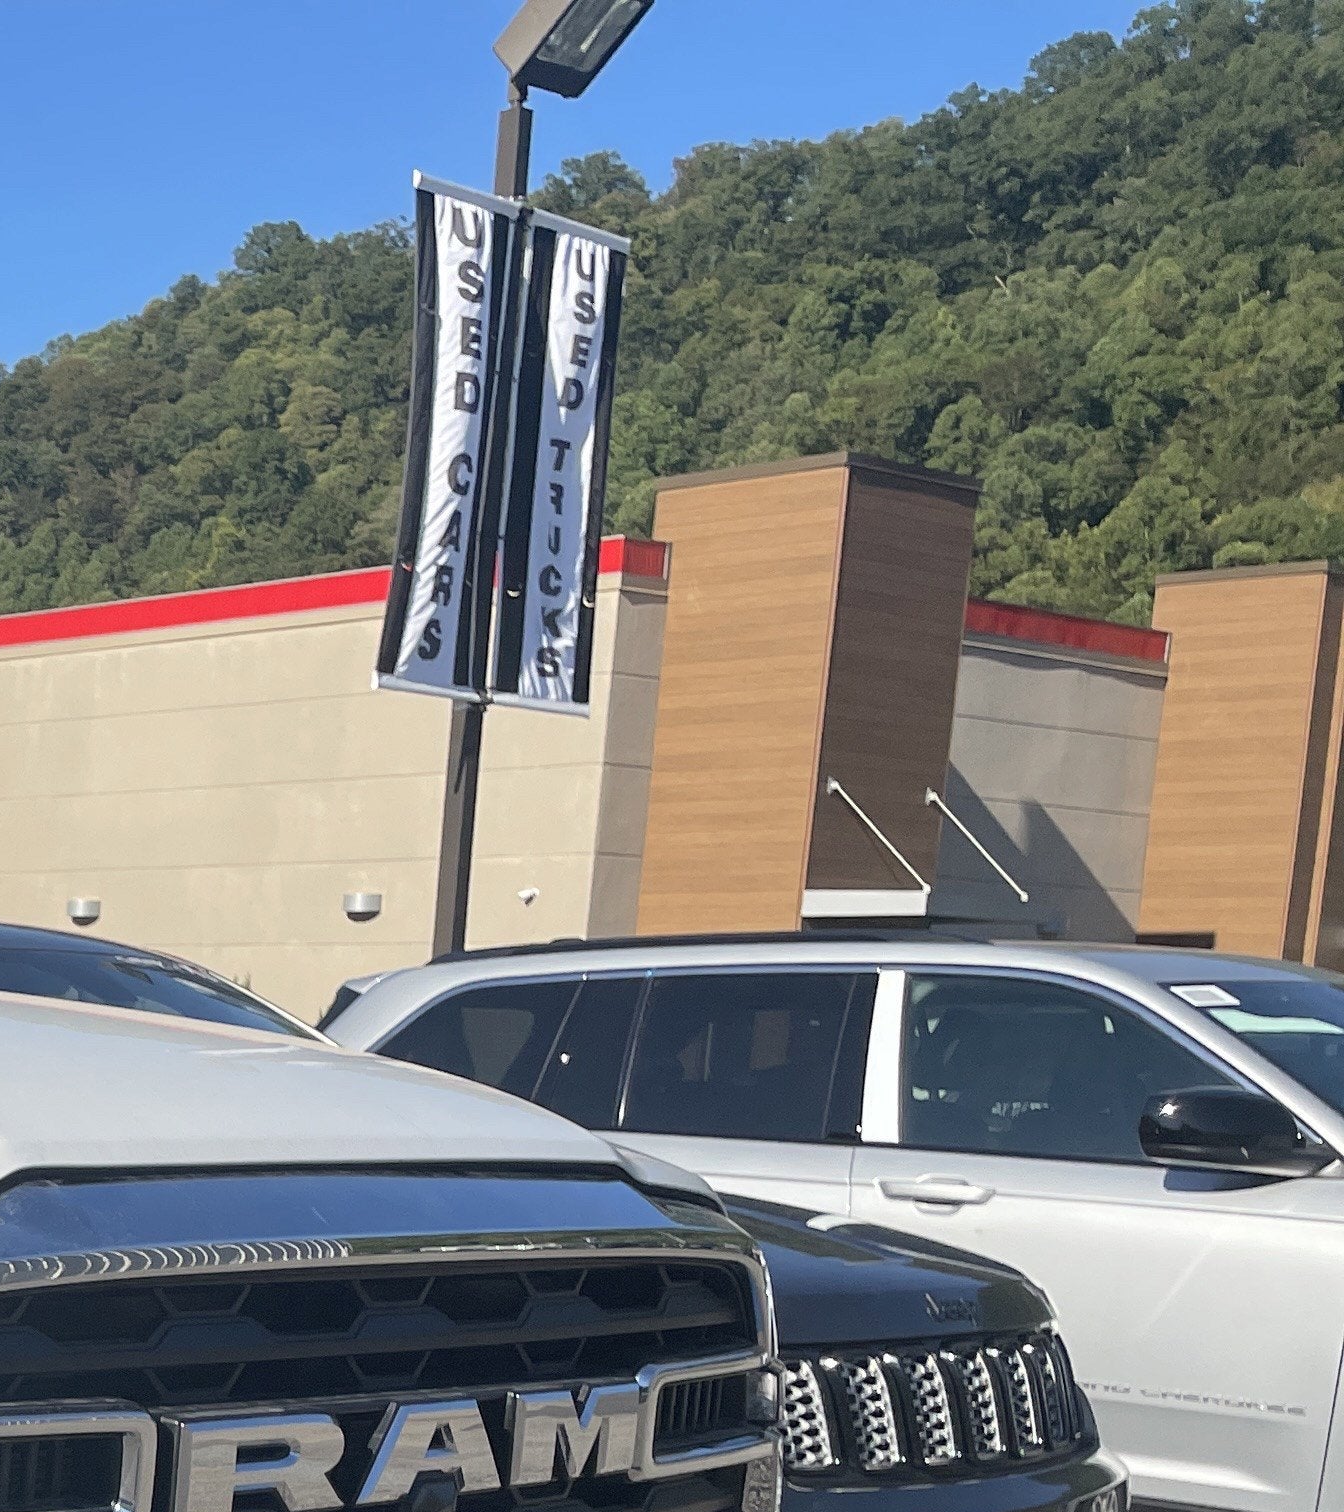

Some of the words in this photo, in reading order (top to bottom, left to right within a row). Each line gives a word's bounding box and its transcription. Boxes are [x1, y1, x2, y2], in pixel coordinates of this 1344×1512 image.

[452, 207, 485, 415] USED
[563, 250, 597, 411] USED
[416, 453, 474, 661] CARS
[536, 437, 572, 679] TRUCKS
